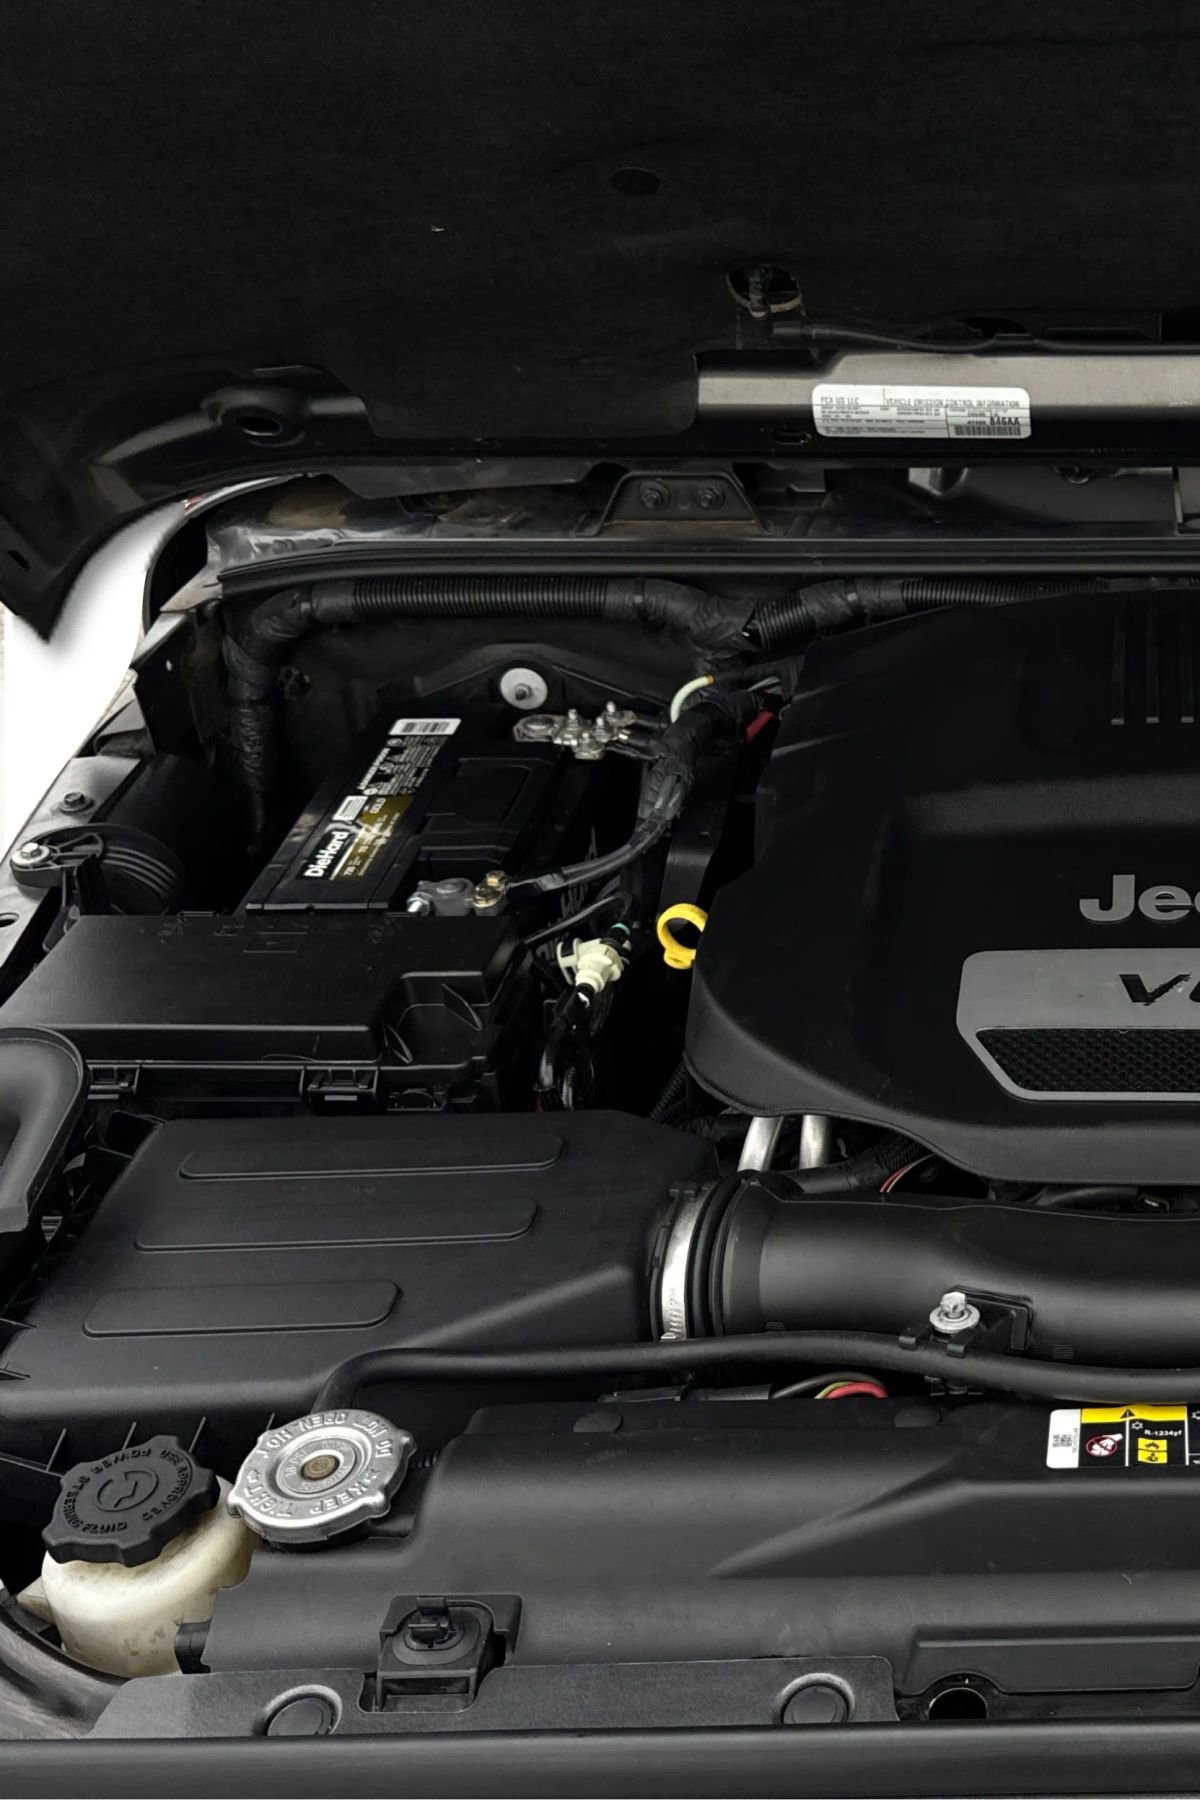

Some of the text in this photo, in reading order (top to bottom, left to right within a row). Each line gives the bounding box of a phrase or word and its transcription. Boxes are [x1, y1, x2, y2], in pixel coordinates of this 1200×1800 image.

[885, 398, 912, 407] VEHICLE
[945, 399, 974, 408] CONTROL
[976, 400, 1020, 409] INFORMATION
[303, 830, 350, 877] DieHard
[299, 1412, 348, 1431] OPEN
[1144, 1429, 1182, 1437] R-1234yf
[256, 1429, 292, 1459] HOT
[310, 1483, 368, 1515] KEEP
